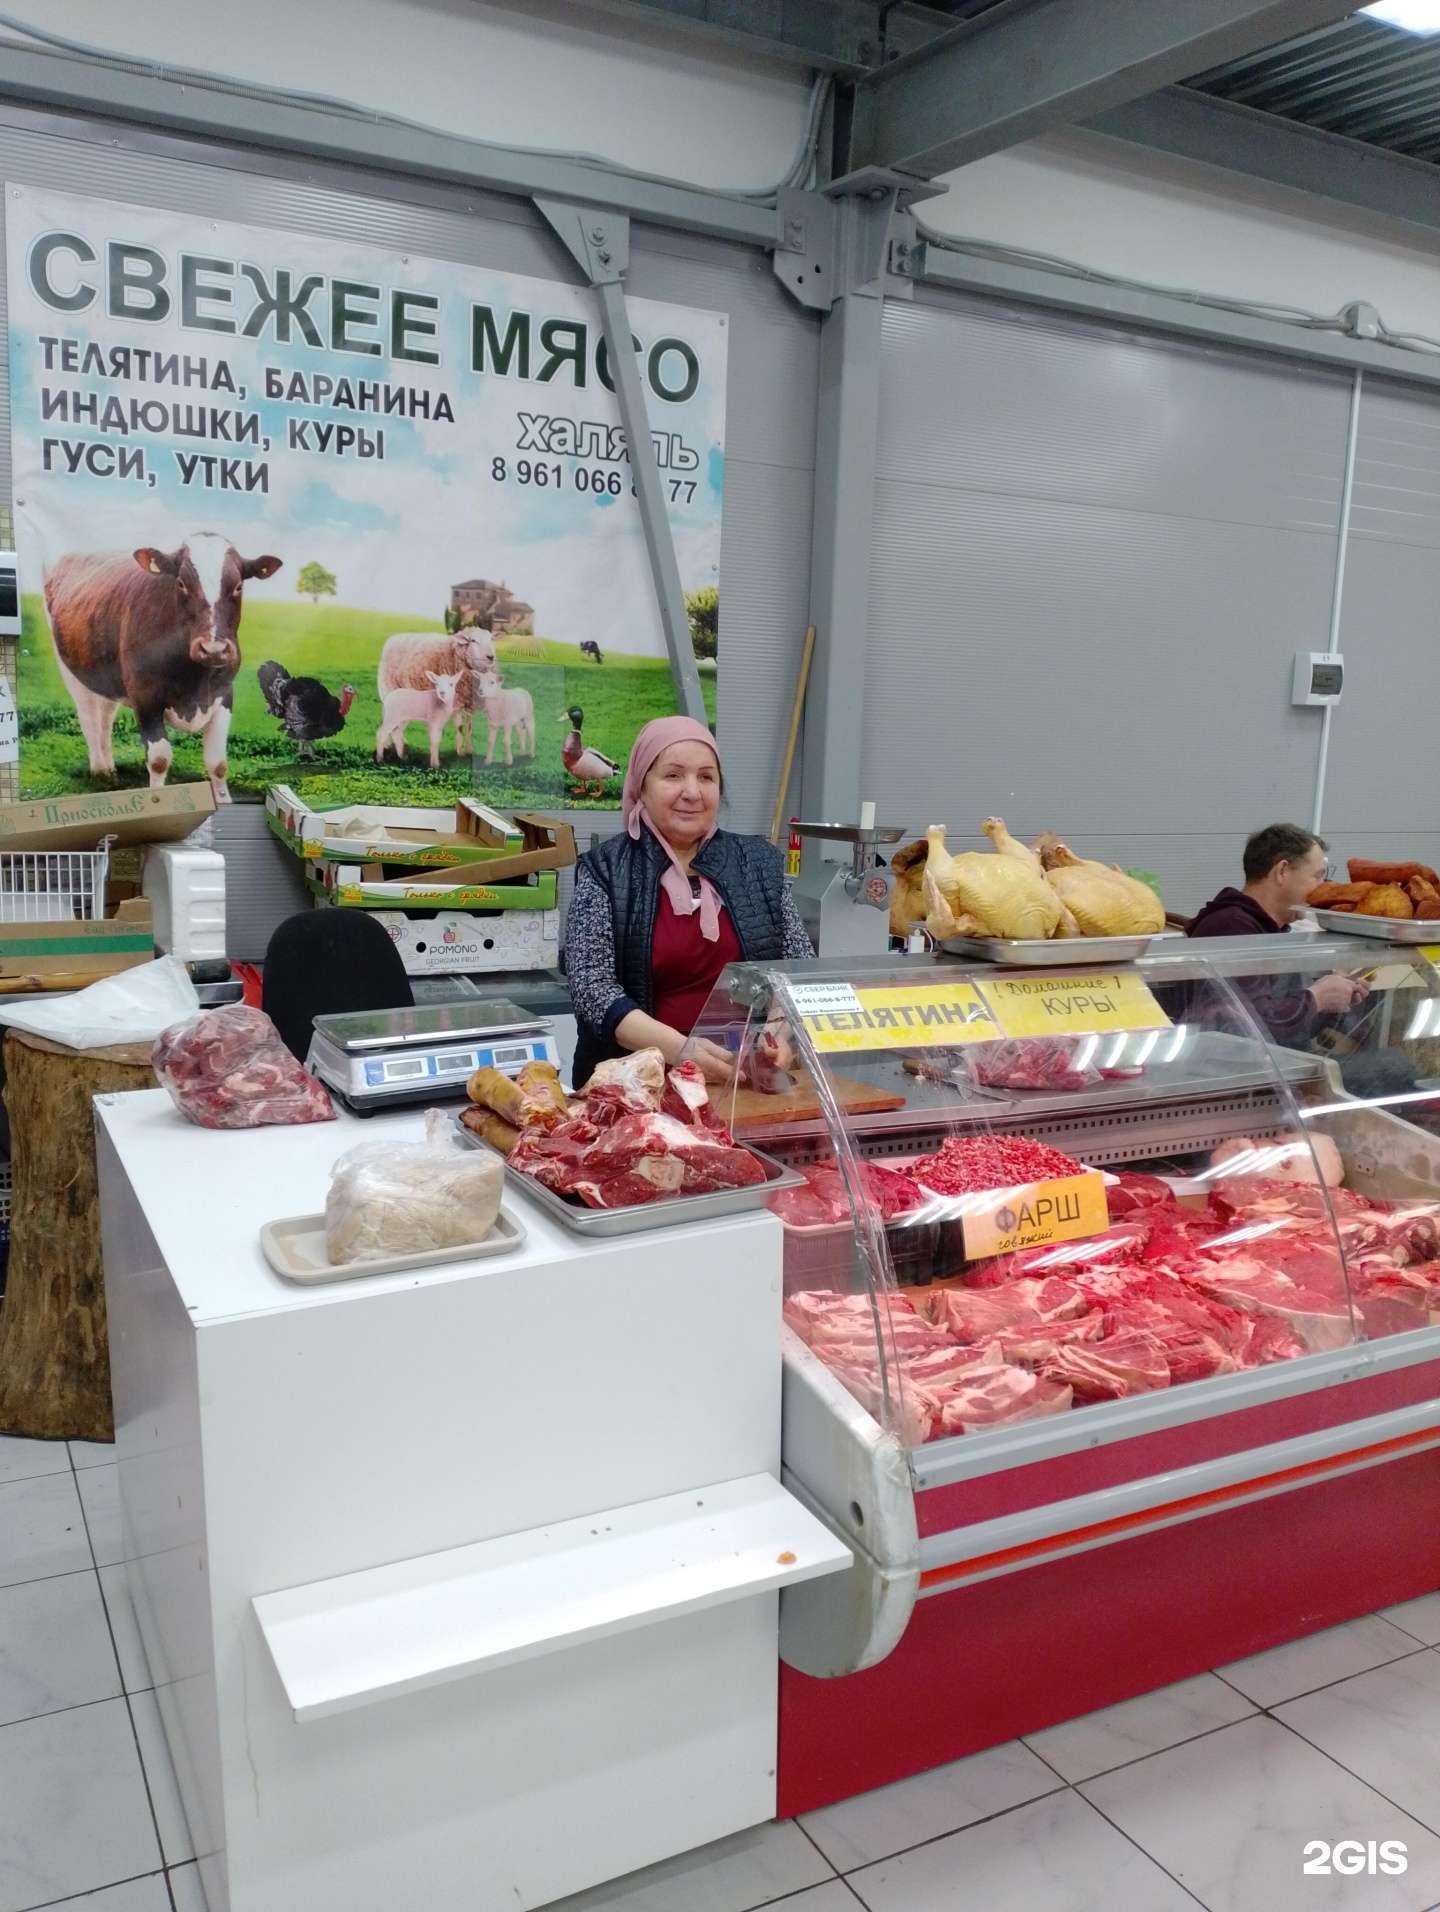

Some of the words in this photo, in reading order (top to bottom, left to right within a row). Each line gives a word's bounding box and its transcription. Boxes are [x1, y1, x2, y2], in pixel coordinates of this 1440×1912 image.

[29, 233, 441, 365] СВЕЖЕЕ
[39, 336, 246, 399] ТЕЛЯТИНА,
[265, 368, 455, 423] БАРАНИНА
[42, 389, 271, 452] ИНДЮШКИ,
[289, 425, 384, 459] КУРЫ
[43, 439, 157, 488] ГУСИ,
[178, 452, 270, 493] УТКИ
[491, 457, 506, 482] 8
[517, 460, 562, 489] 961
[575, 467, 622, 495] 066
[429, 944, 478, 956] POMONO
[460, 956, 480, 964] FRUIT
[1041, 995, 1118, 1015] КУРЫ
[995, 1193, 1080, 1233] ФАРШ
